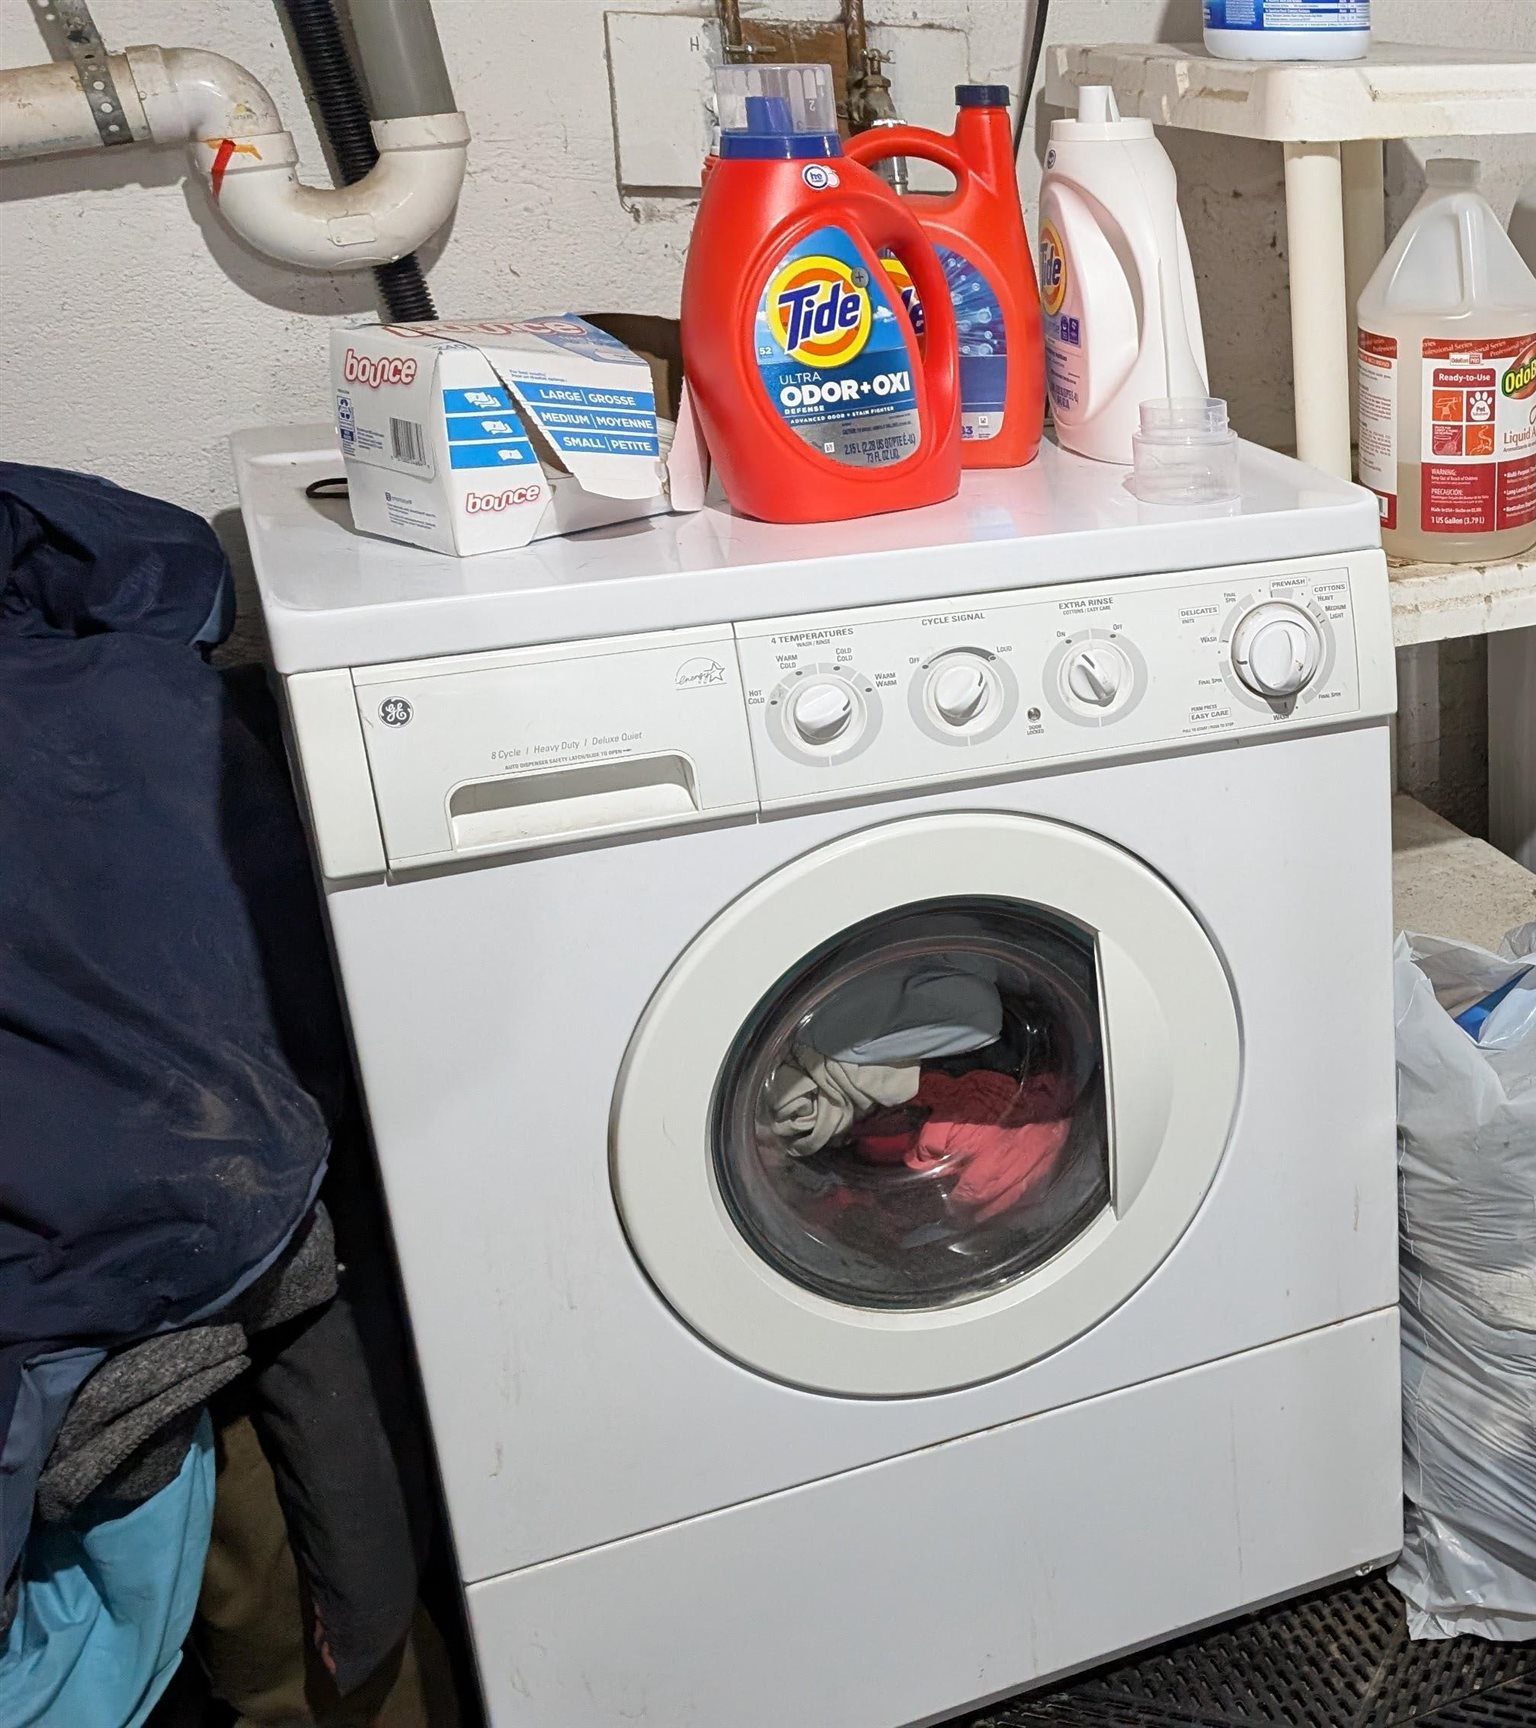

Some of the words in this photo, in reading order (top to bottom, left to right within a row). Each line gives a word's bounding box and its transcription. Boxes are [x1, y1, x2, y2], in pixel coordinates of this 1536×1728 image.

[777, 279, 862, 355] Tide
[759, 347, 772, 355] 52
[344, 348, 418, 389] bounce
[779, 371, 822, 385] ULTRA
[1438, 373, 1491, 383] Ready-to-Use
[780, 371, 911, 408] ODOR+OXI
[539, 389, 583, 402] LARGE
[589, 393, 637, 406] GROSSE
[784, 405, 825, 416] DEFENSE
[790, 416, 826, 424] ADVANCED
[851, 409, 871, 418] STAIN
[871, 405, 894, 414] FIGHTER
[596, 415, 654, 430] MOYENNE
[1503, 426, 1531, 446] Liquid
[563, 436, 606, 449] SMALL
[611, 439, 653, 451] PETITE
[466, 484, 541, 514] bounce
[1444, 516, 1463, 524] Gallon
[1464, 516, 1479, 525] (3.79
[1271, 578, 1306, 588] PREWASH
[1313, 583, 1346, 593] COTTONS
[1058, 601, 1087, 610] EXTRA
[1088, 597, 1114, 606] RINSE
[1062, 608, 1084, 616] COTTONS
[1180, 607, 1218, 617] DELICATES
[921, 616, 950, 627] CYCLE
[951, 612, 986, 623] SIGNAL
[770, 636, 777, 645] 4
[778, 627, 854, 644] TEMPERATURES
[816, 638, 831, 646] RINSE
[382, 699, 410, 725] GE
[1204, 703, 1218, 711] PRESS
[1191, 712, 1209, 721] EASY
[1211, 709, 1229, 717] CARE
[491, 752, 497, 760] 8
[498, 749, 521, 759] Cycle
[533, 744, 560, 754] Heavy
[561, 741, 580, 751] Duty
[592, 735, 620, 746] Deluxe
[621, 731, 642, 742] Quiet
[520, 759, 549, 769] DISPENSER
